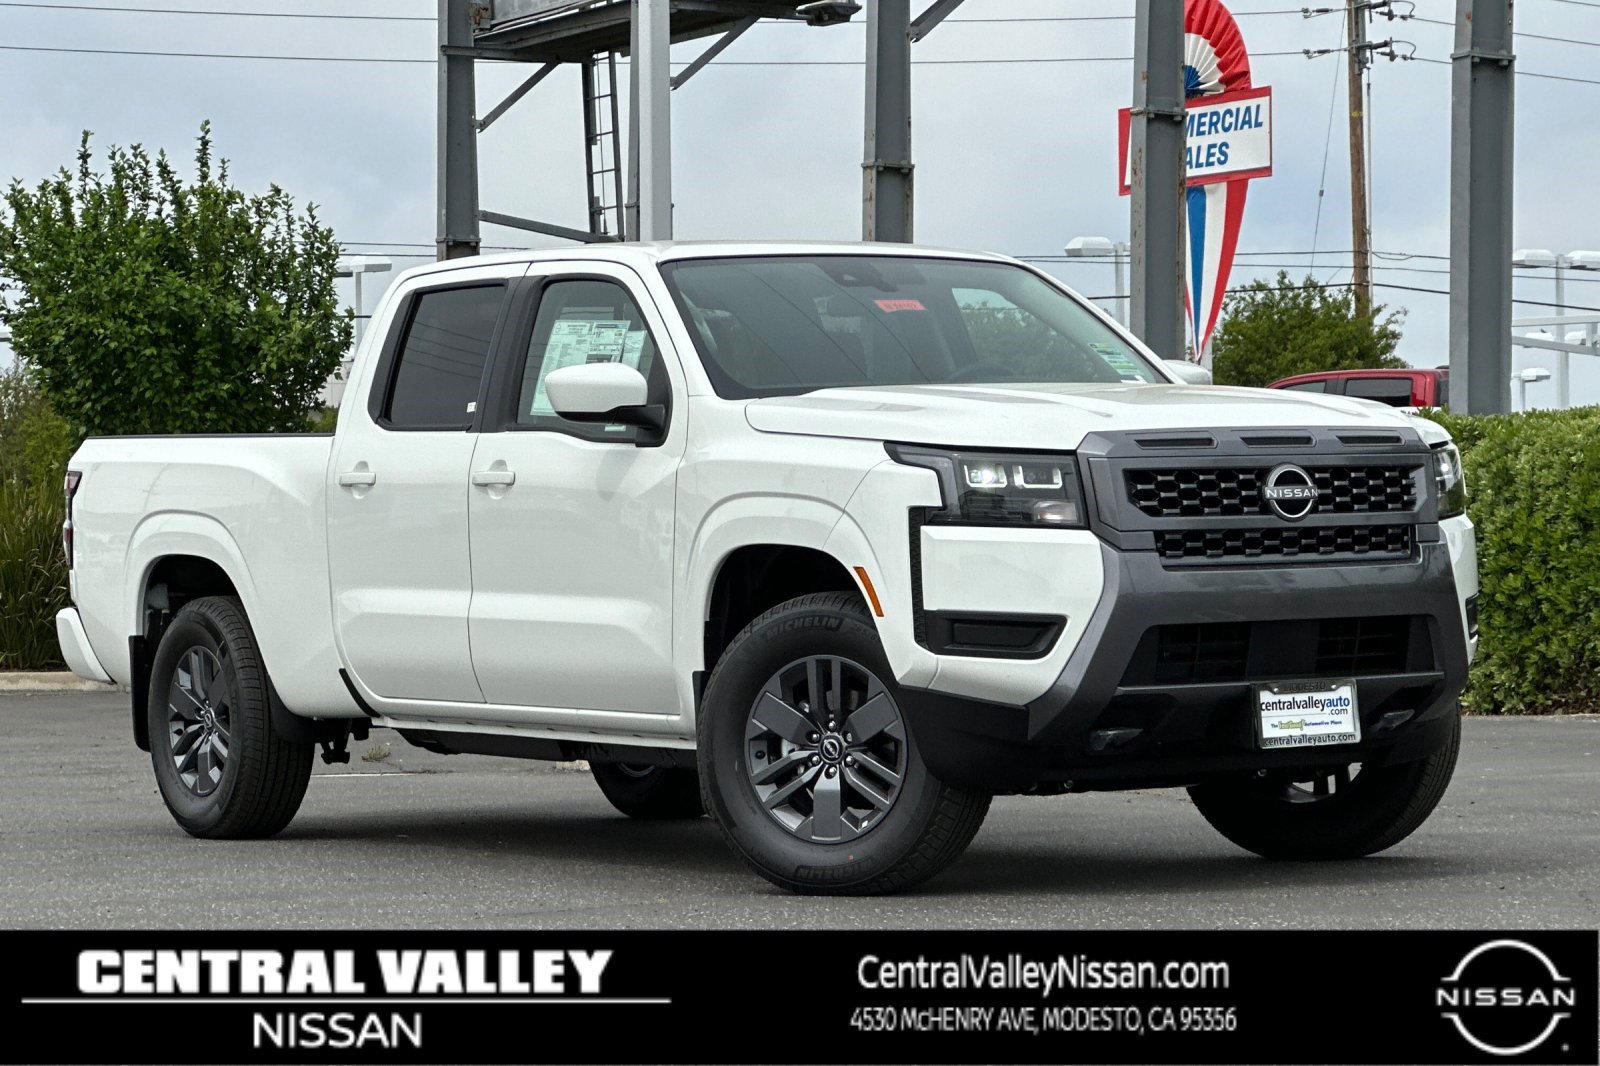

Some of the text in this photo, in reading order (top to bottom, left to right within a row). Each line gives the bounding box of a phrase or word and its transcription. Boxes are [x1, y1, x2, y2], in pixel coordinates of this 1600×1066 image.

[1186, 104, 1263, 137] MERCIAL
[1186, 141, 1230, 169] ALES
[1266, 488, 1318, 498] NISSAN
[766, 616, 841, 639] MICHELIN
[1260, 695, 1350, 712] centralvalleyauto
[1265, 733, 1356, 746] centralvalleyauto.com
